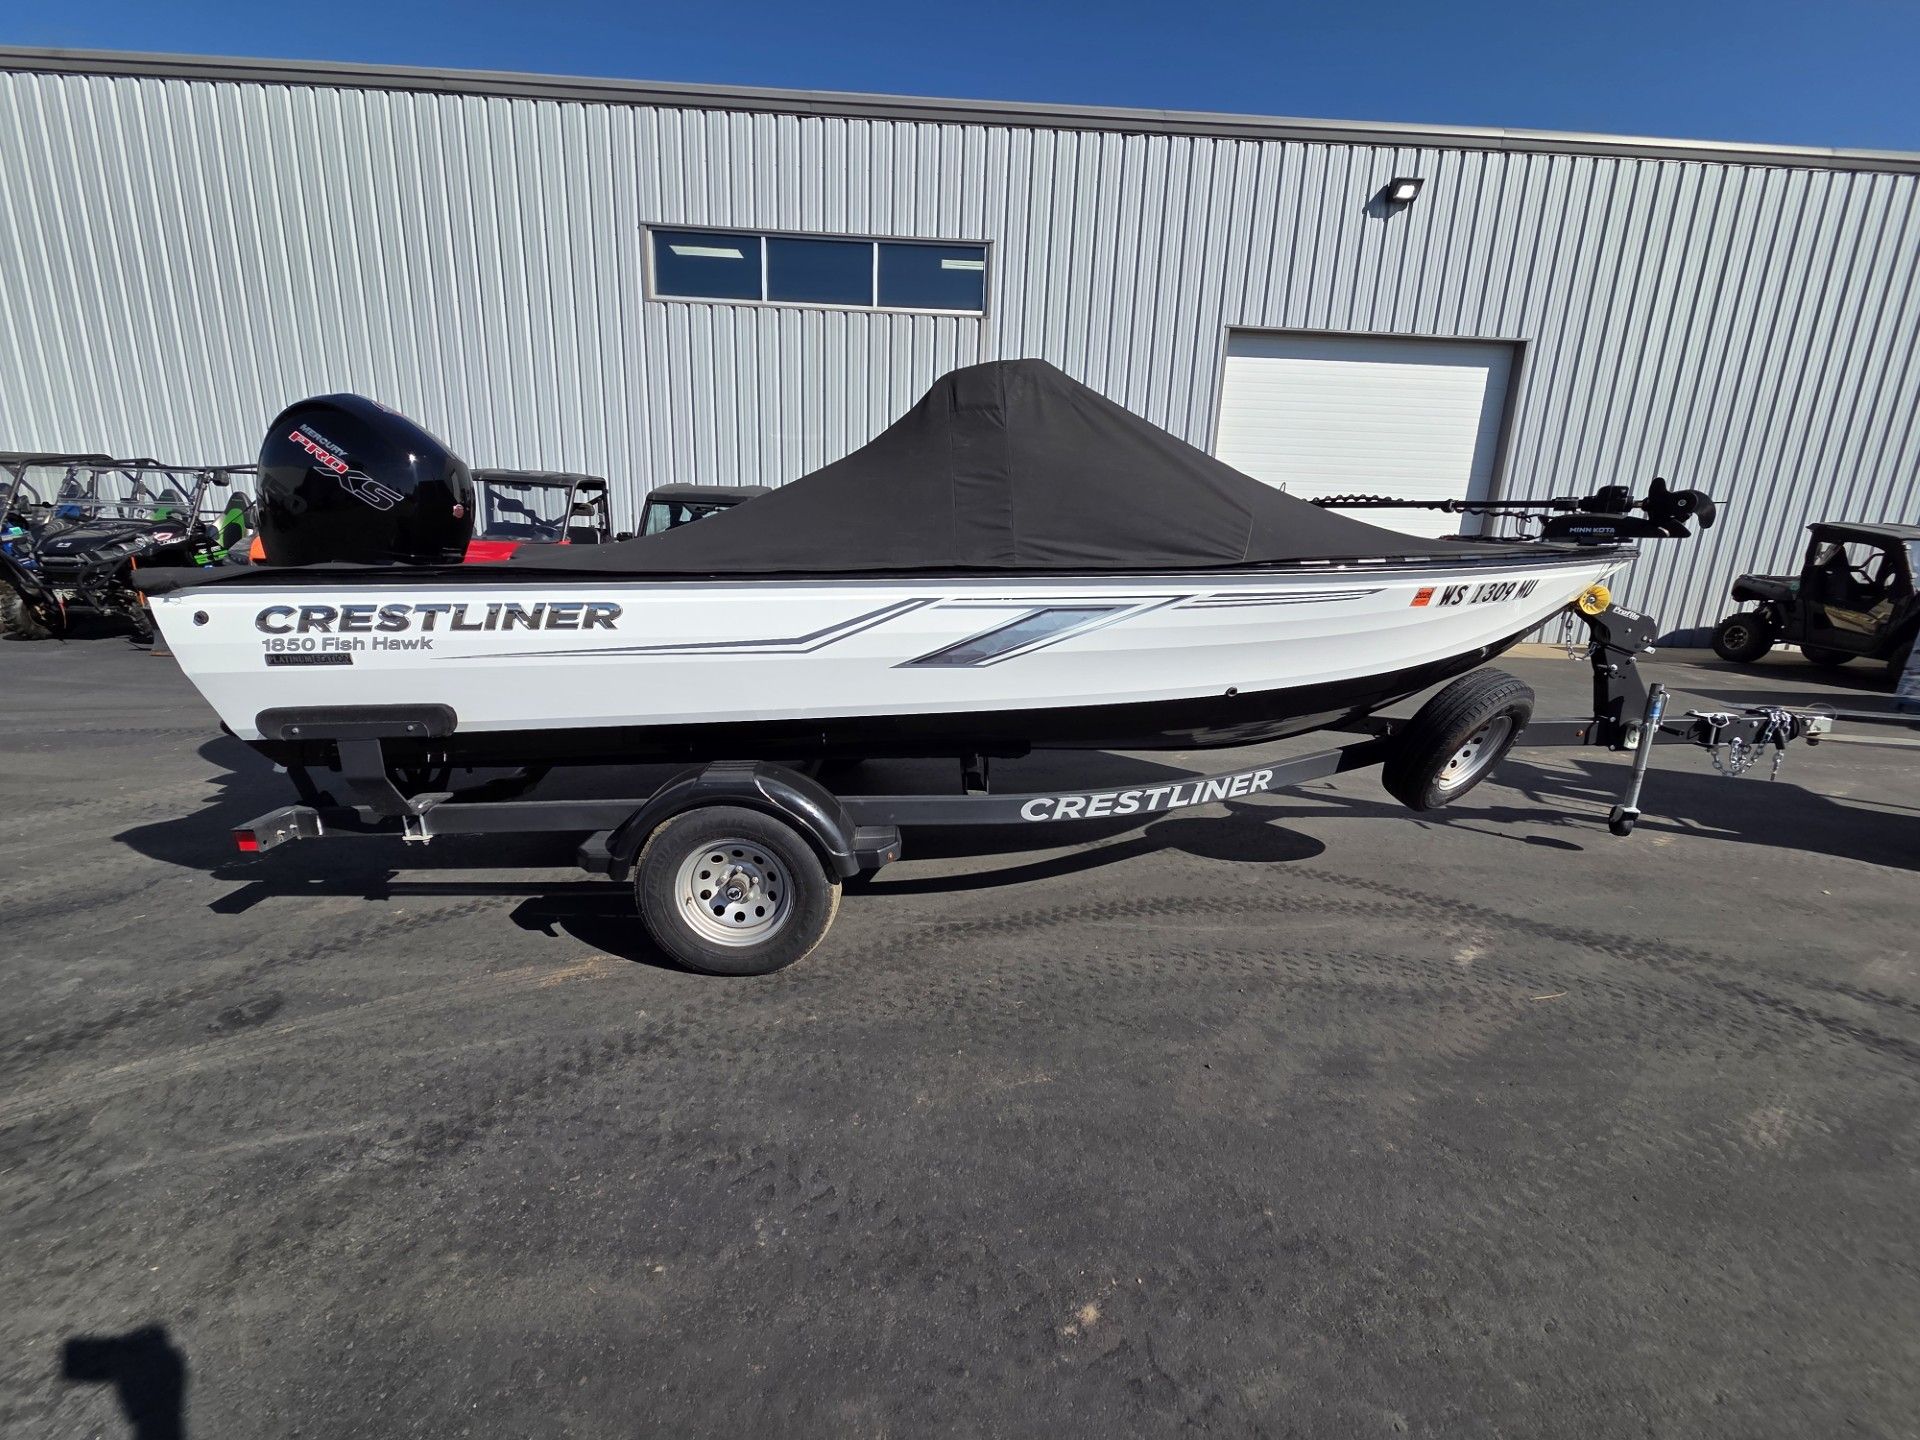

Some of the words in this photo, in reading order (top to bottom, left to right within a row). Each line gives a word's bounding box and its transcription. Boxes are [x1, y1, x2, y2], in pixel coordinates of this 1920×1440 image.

[288, 431, 349, 474] PRO
[300, 424, 348, 457] MERCURY
[313, 466, 404, 511] XS
[1439, 584, 1469, 606] WS
[1471, 581, 1517, 604] 1309
[255, 602, 623, 634] CRESTLINER
[262, 638, 316, 652] 1850
[322, 636, 366, 651] Fish
[372, 635, 433, 650] Hawk
[1020, 769, 1273, 821] CRESTLINER
